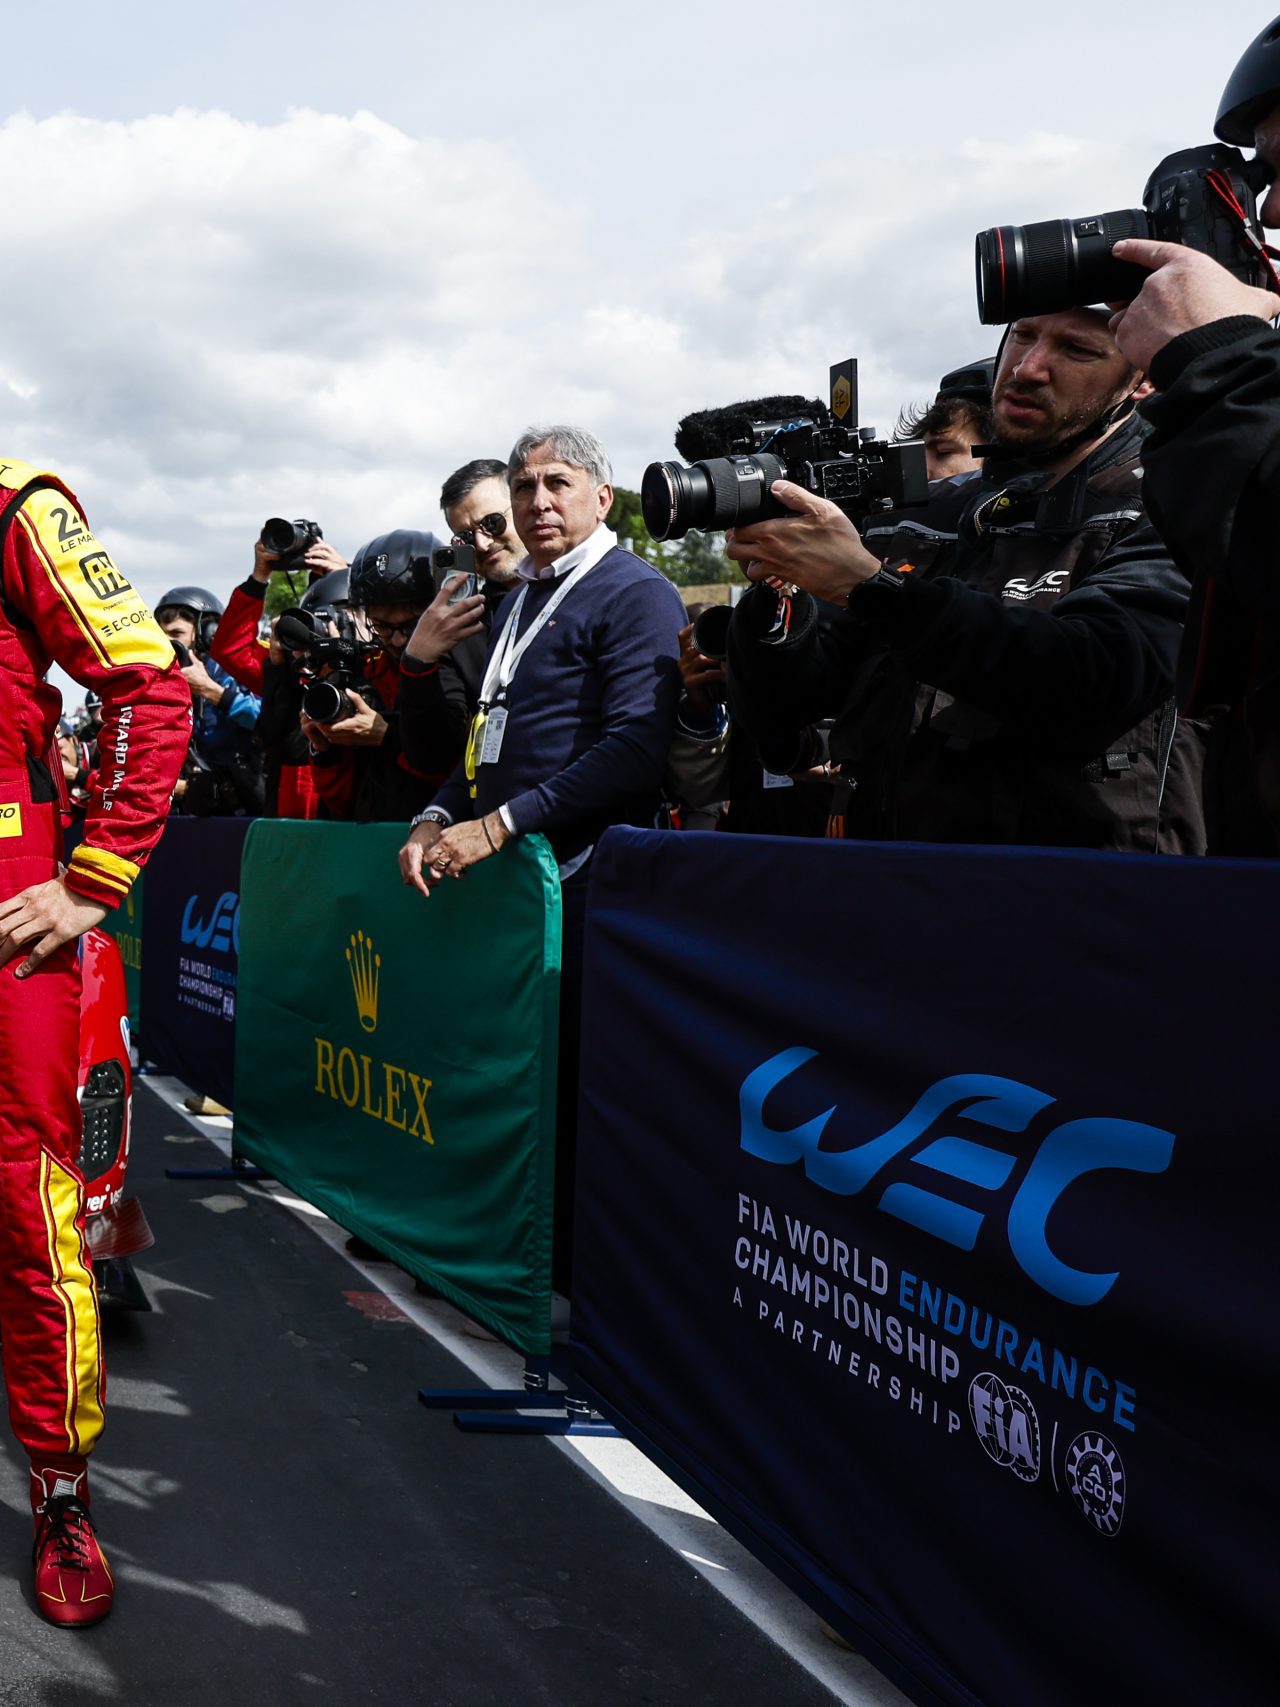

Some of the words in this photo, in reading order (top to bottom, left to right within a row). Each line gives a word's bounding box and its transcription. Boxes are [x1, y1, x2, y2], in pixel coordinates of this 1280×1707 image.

[60, 539, 76, 553] LE
[77, 534, 95, 545] MA
[191, 960, 211, 979] WORLD
[314, 1038, 435, 1146] ROLEX
[739, 1046, 1176, 1306] WEC
[733, 1286, 743, 1308] A
[759, 1301, 961, 1433] PARTNERSHIP
[735, 1236, 960, 1384] CHAMPIONSHIP
[738, 1192, 777, 1240] FIA
[785, 1214, 889, 1296] WORLD
[899, 1270, 1136, 1432] ENDURANCE
[973, 1383, 1038, 1470] FIA
